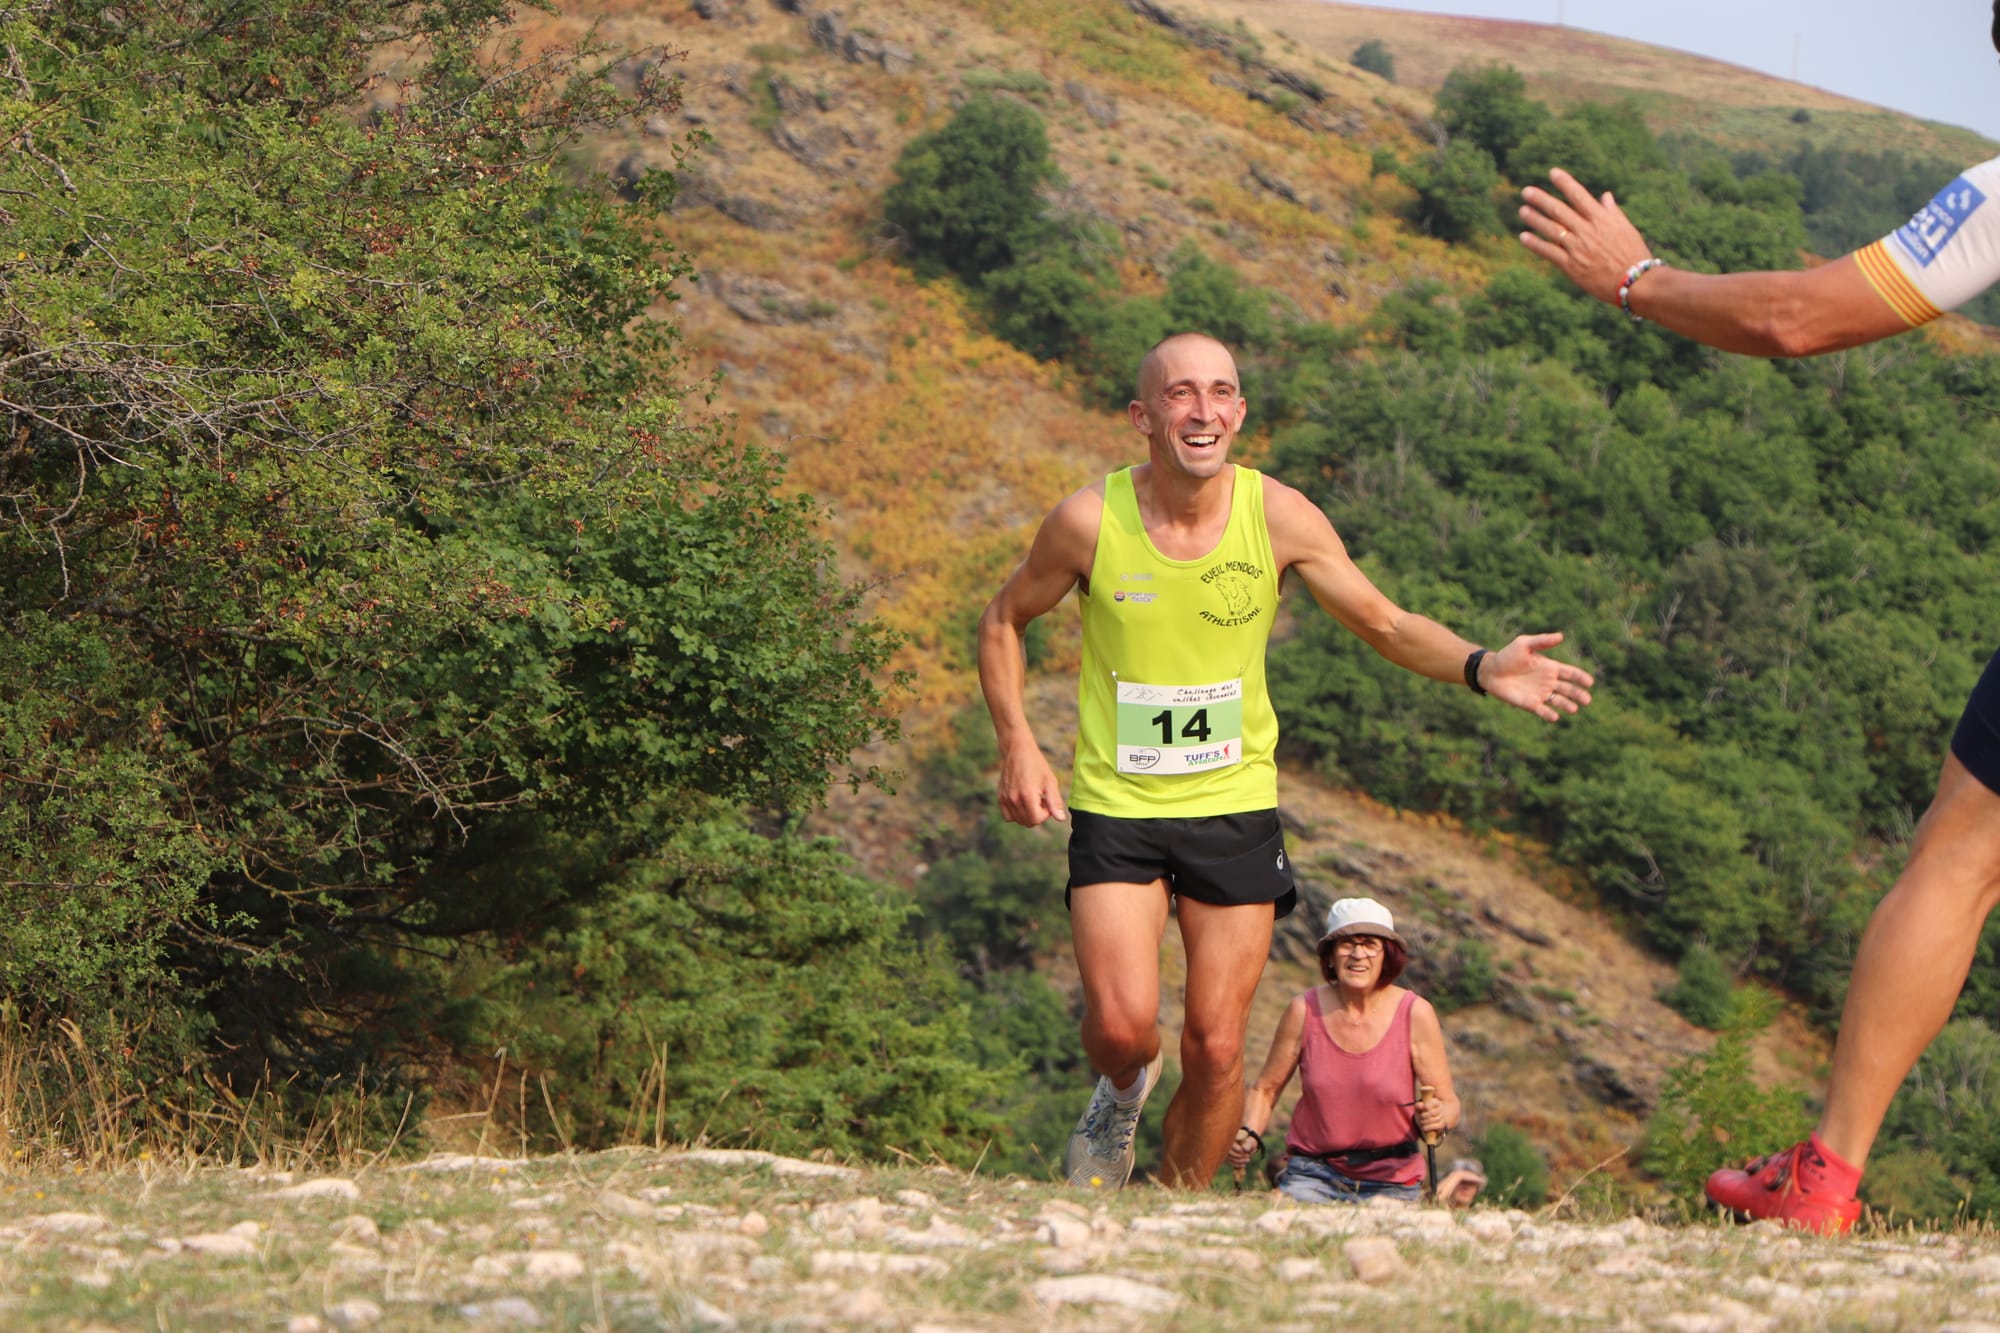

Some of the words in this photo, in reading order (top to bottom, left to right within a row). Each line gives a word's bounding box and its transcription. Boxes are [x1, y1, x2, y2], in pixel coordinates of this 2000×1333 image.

[1200, 564, 1225, 584] EVEIL
[1225, 560, 1263, 579] MENDOIS
[1199, 606, 1262, 627] ATHLETISME
[1152, 708, 1211, 744] 14
[1129, 753, 1156, 762] BFP
[1184, 749, 1220, 762] TUFF'S
